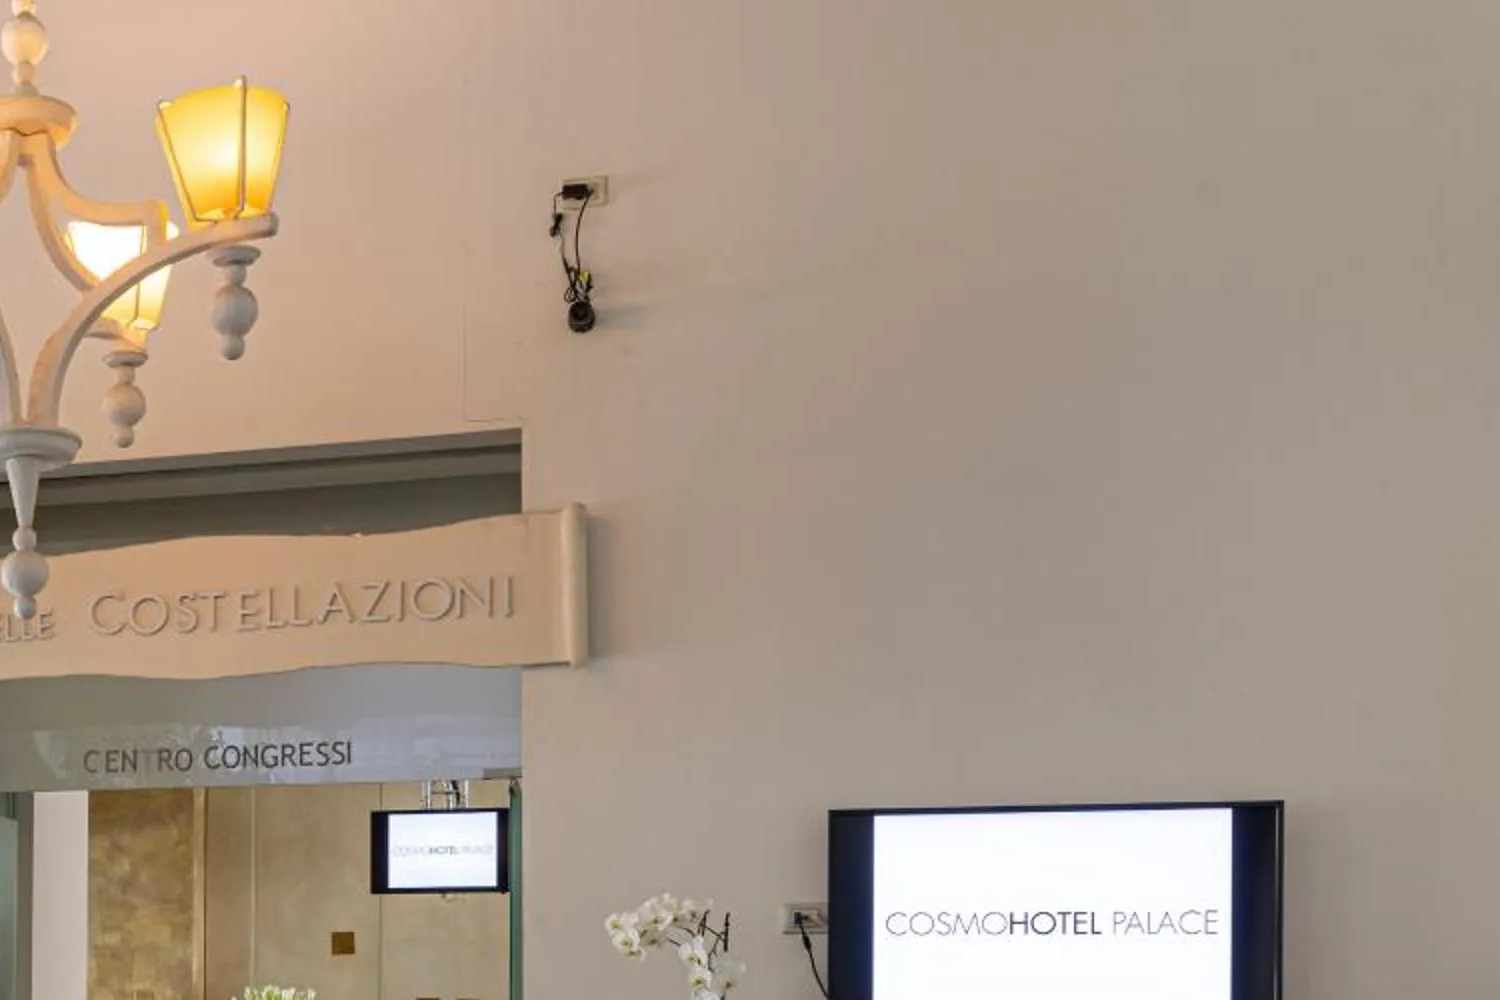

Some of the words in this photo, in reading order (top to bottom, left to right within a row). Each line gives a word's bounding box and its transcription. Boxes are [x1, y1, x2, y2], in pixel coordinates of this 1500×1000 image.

[89, 574, 516, 637] COSTELLAZIONI
[83, 748, 193, 774] CENTRO
[204, 740, 353, 769] CONGRESSI
[885, 911, 1102, 936] COSMOHOTEL
[1112, 909, 1219, 935] PALACE
